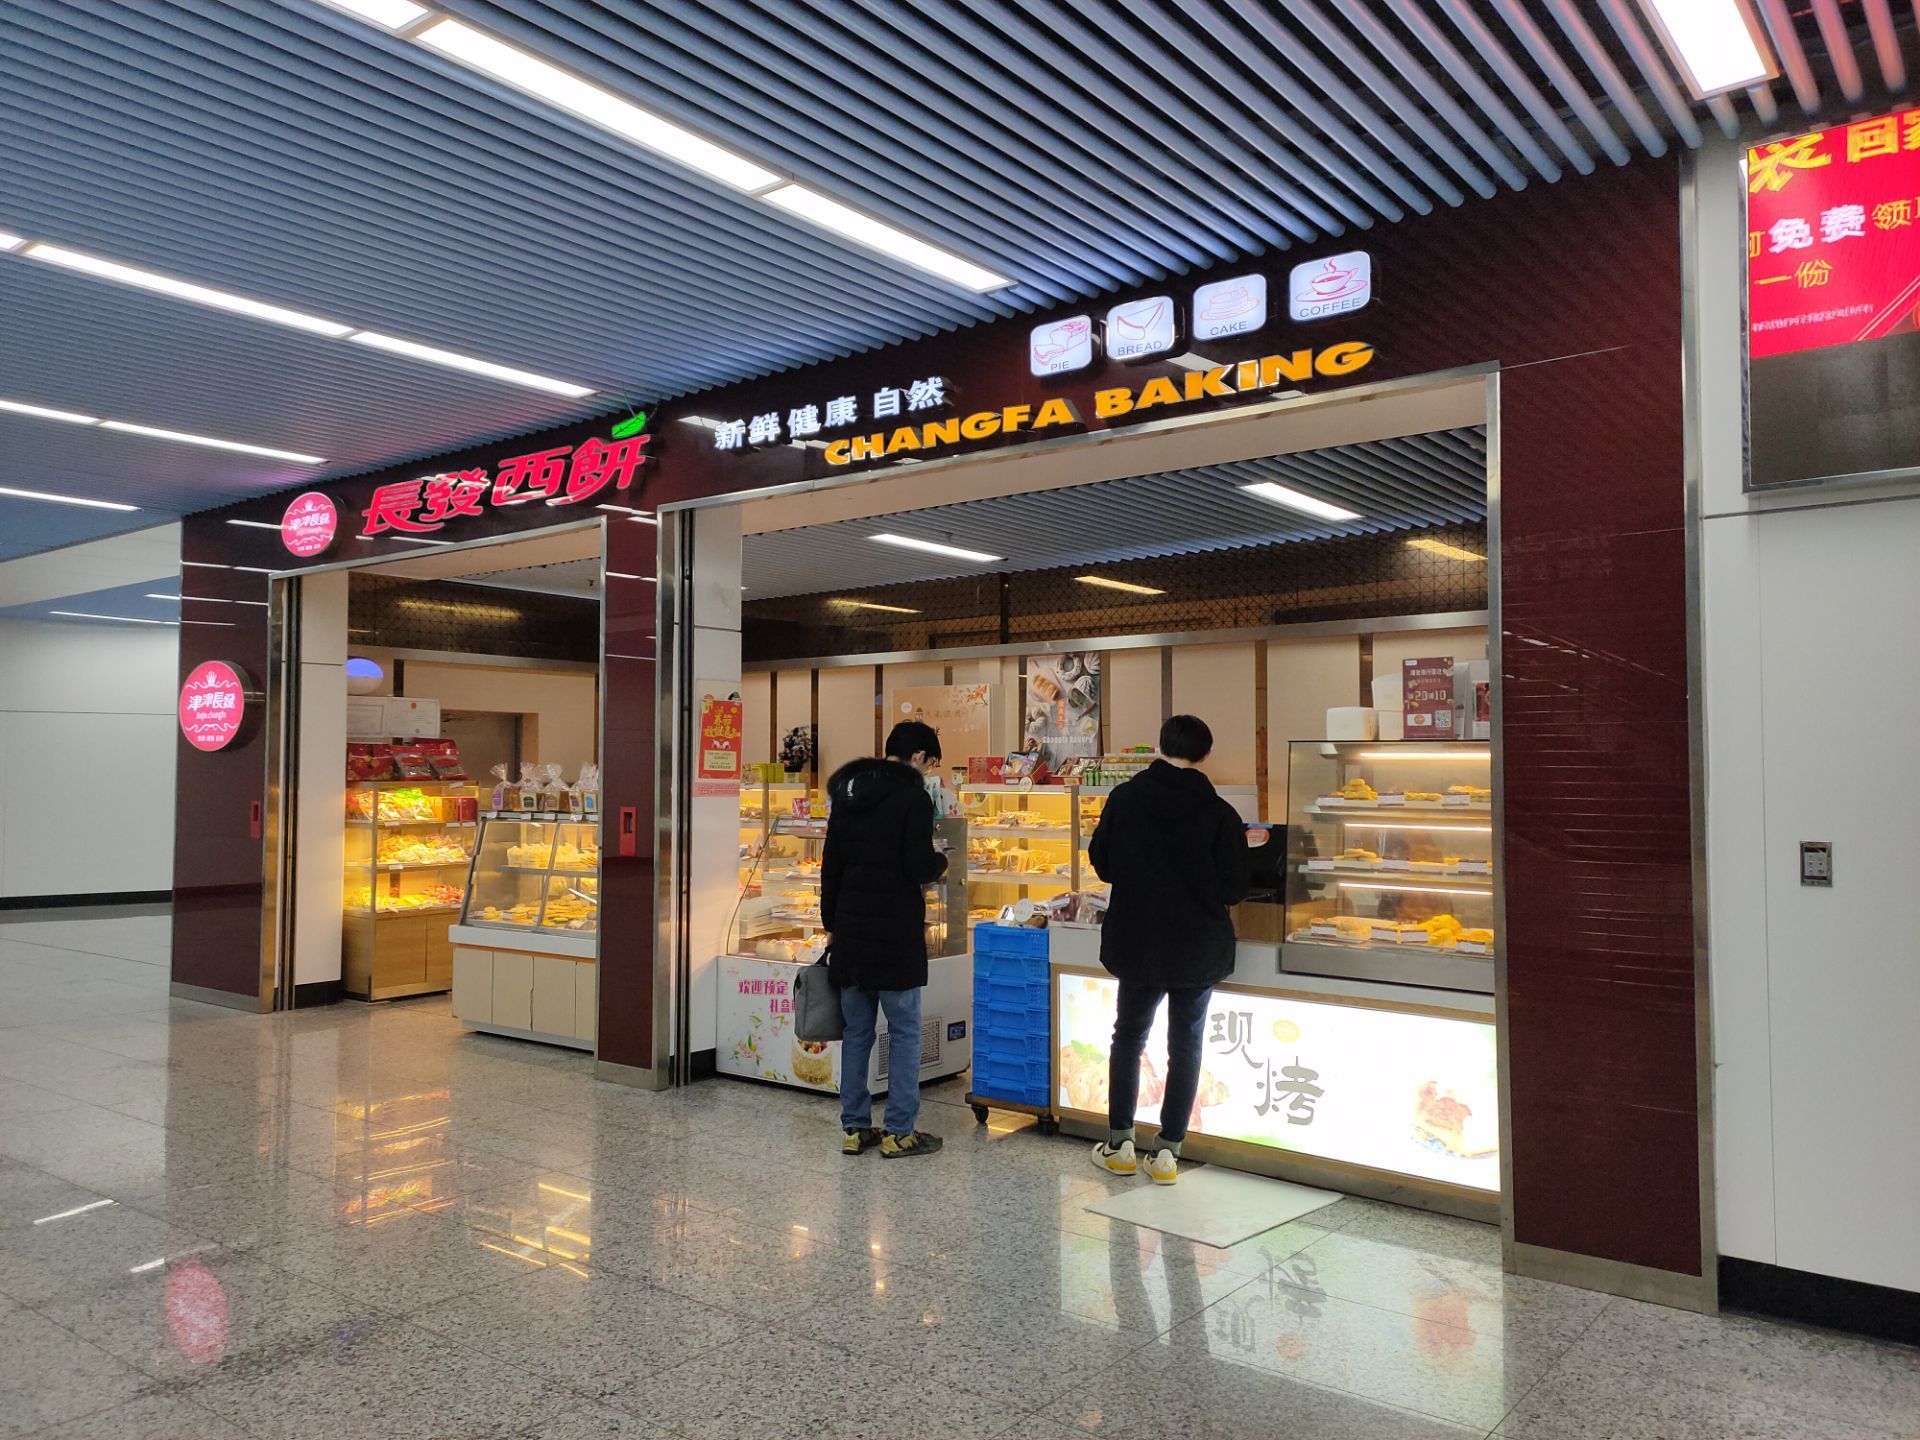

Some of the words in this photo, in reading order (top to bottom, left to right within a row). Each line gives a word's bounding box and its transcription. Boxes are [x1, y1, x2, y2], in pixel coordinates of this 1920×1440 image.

[1755, 260, 1832, 288] 一份
[1299, 297, 1361, 318] COFFEE
[1210, 320, 1247, 336] CAKE
[1117, 340, 1162, 356] BREAD
[1050, 361, 1070, 372] PIE
[714, 411, 781, 450] 新鲜
[787, 396, 858, 437] 健康
[873, 376, 944, 418] 自然
[824, 398, 1076, 465] CHANGFA
[1095, 341, 1375, 419] BAKING
[738, 980, 789, 995] 欢迎预定
[1209, 1011, 1325, 1125] 现烤
